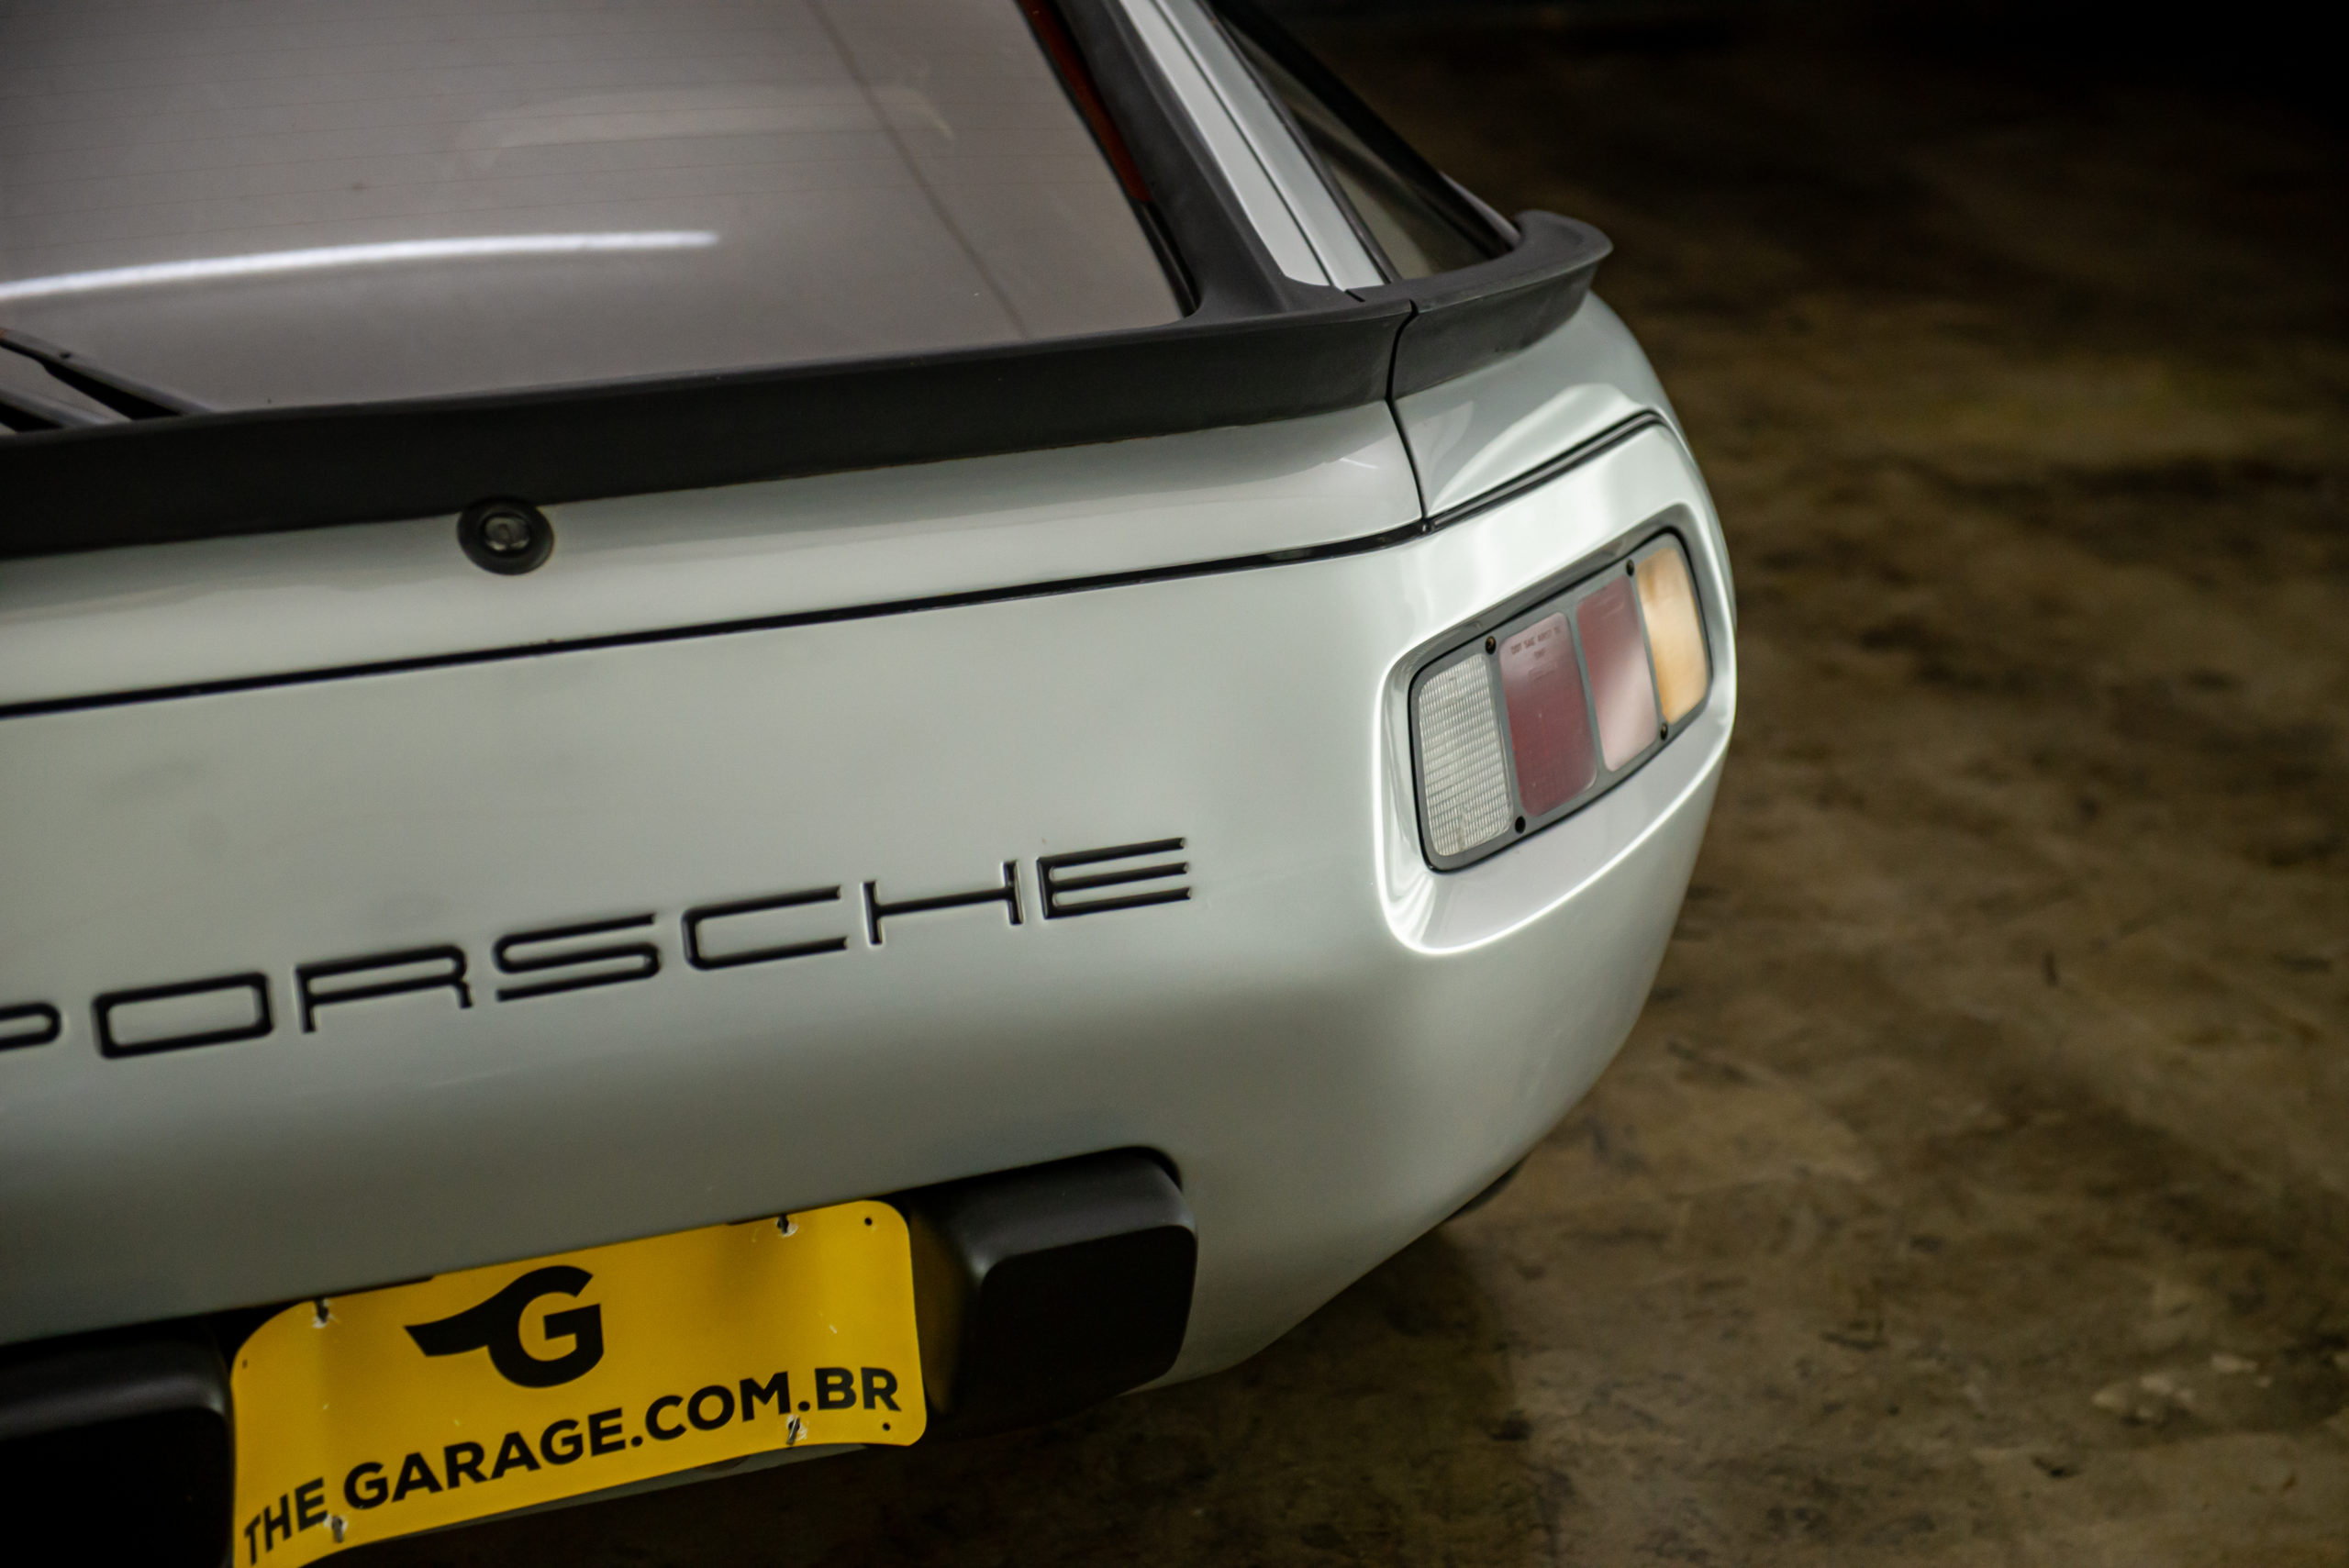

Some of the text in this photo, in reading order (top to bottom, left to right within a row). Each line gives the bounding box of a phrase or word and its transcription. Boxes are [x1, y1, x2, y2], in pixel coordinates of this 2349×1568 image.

[487, 1265, 605, 1389] G
[243, 1366, 902, 1566] THE GARAGE.COM.BR
